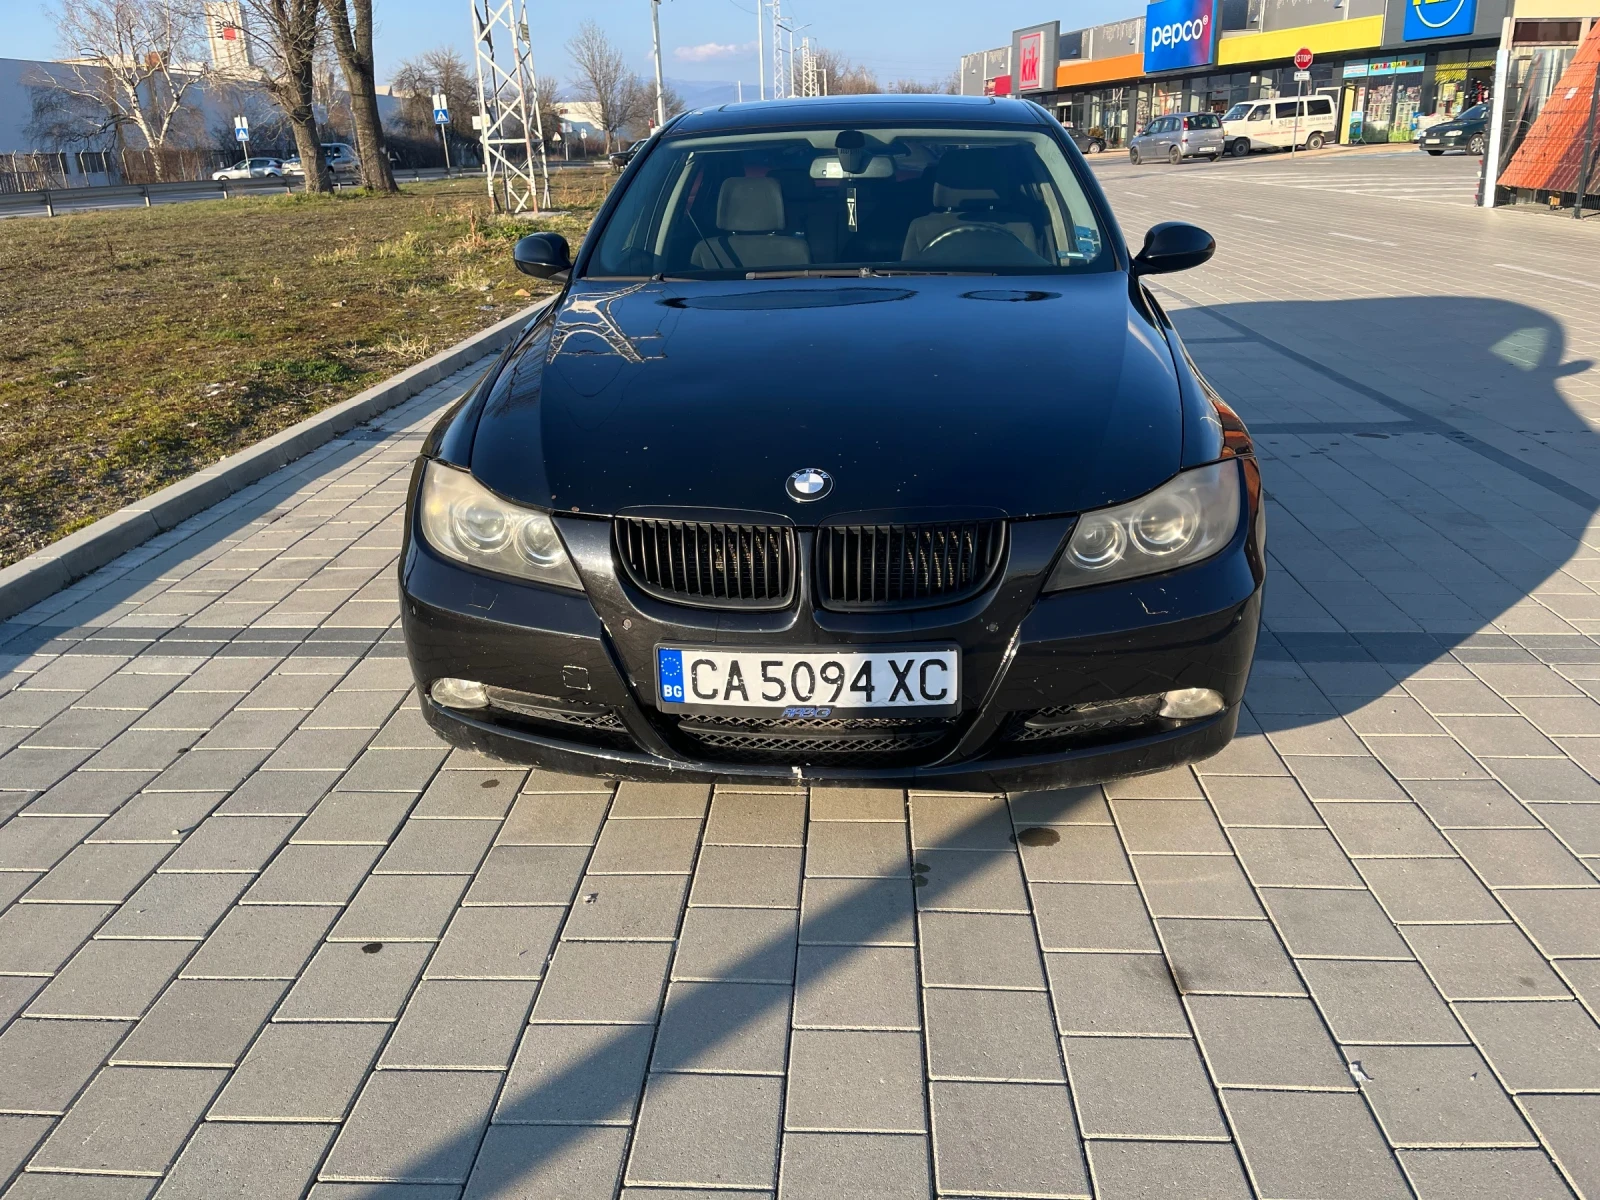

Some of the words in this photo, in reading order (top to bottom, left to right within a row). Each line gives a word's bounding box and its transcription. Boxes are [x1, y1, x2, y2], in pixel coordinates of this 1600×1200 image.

[1151, 18, 1203, 52] pepco
[1296, 54, 1312, 63] STOP
[663, 684, 683, 698] BG
